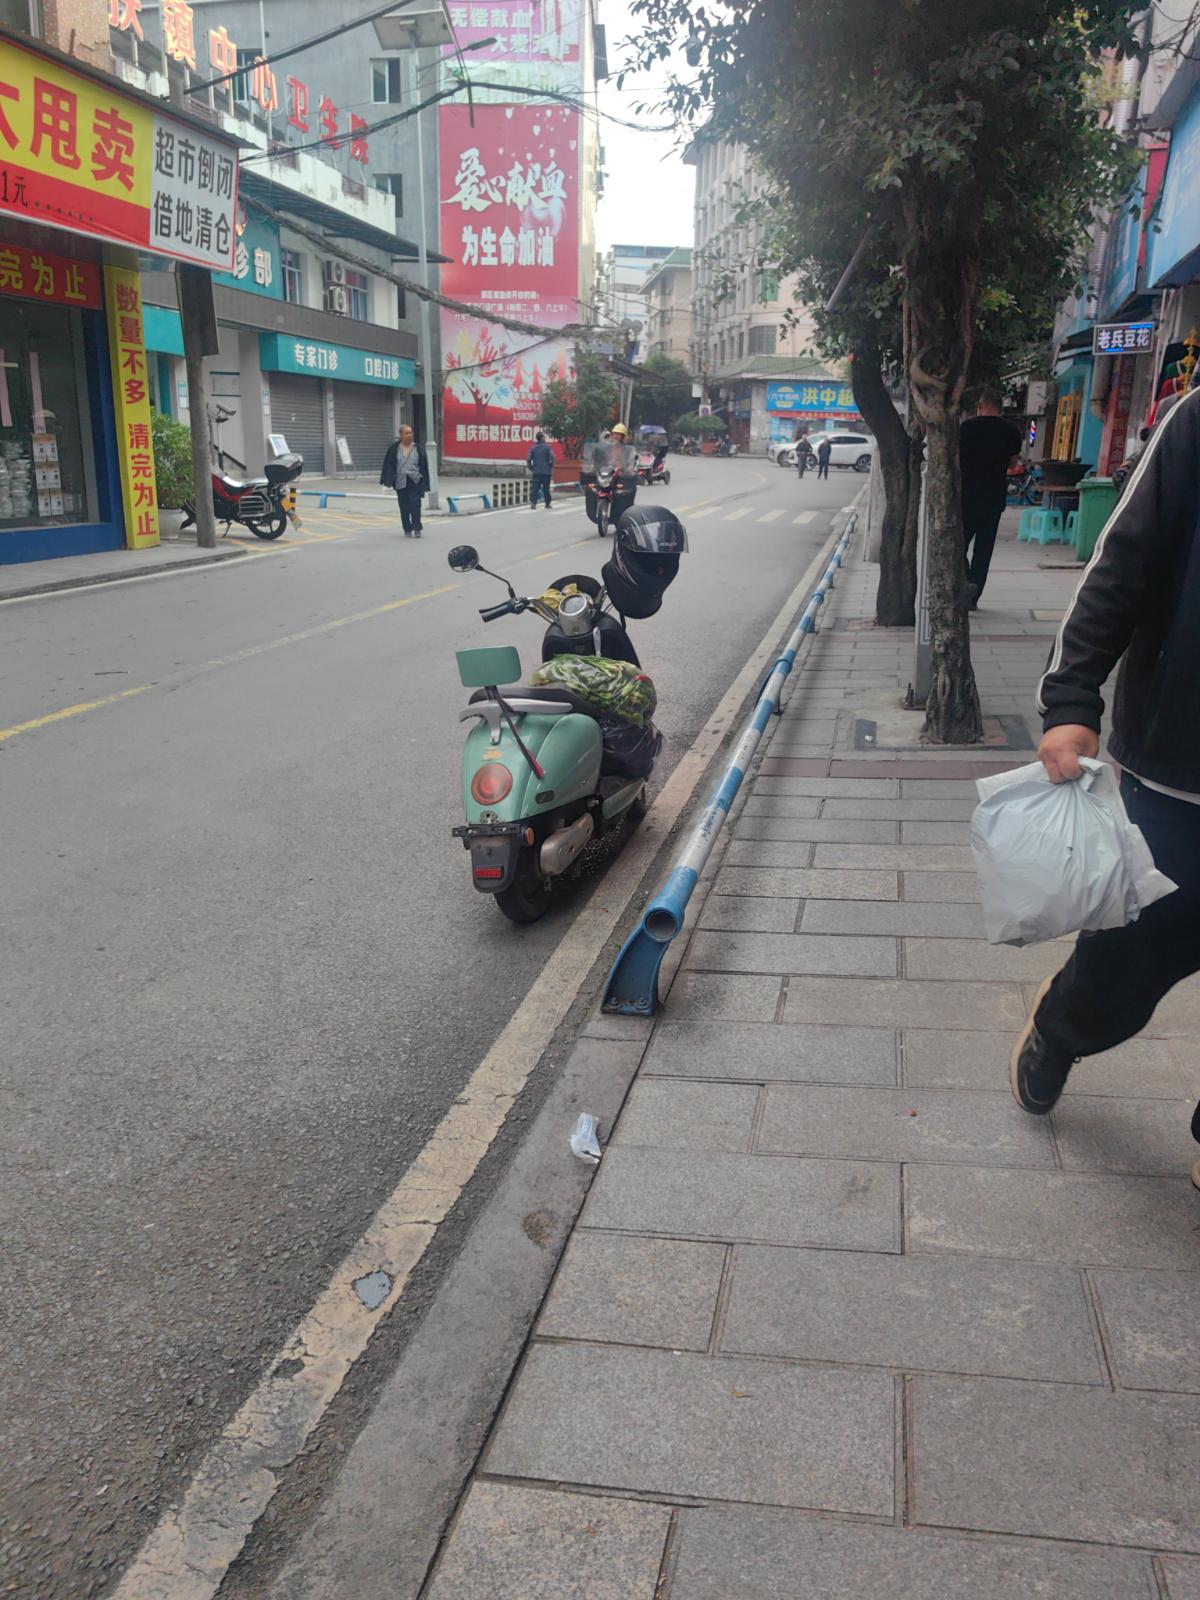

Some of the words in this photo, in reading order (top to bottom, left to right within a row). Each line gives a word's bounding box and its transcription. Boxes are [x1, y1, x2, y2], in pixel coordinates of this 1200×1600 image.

[451, 7, 534, 28] 无偿献血
[154, 127, 234, 201] 超市倒闭
[440, 147, 567, 213] 爱心献血
[154, 190, 231, 256] 借地清仓
[461, 225, 555, 268] 为生命加油
[116, 284, 146, 405] 数量不多
[294, 343, 338, 372] 专家门诊
[1098, 328, 1150, 349] 老兵豆花
[364, 357, 400, 381] 口腔门诊
[128, 422, 158, 537] 清完为止
